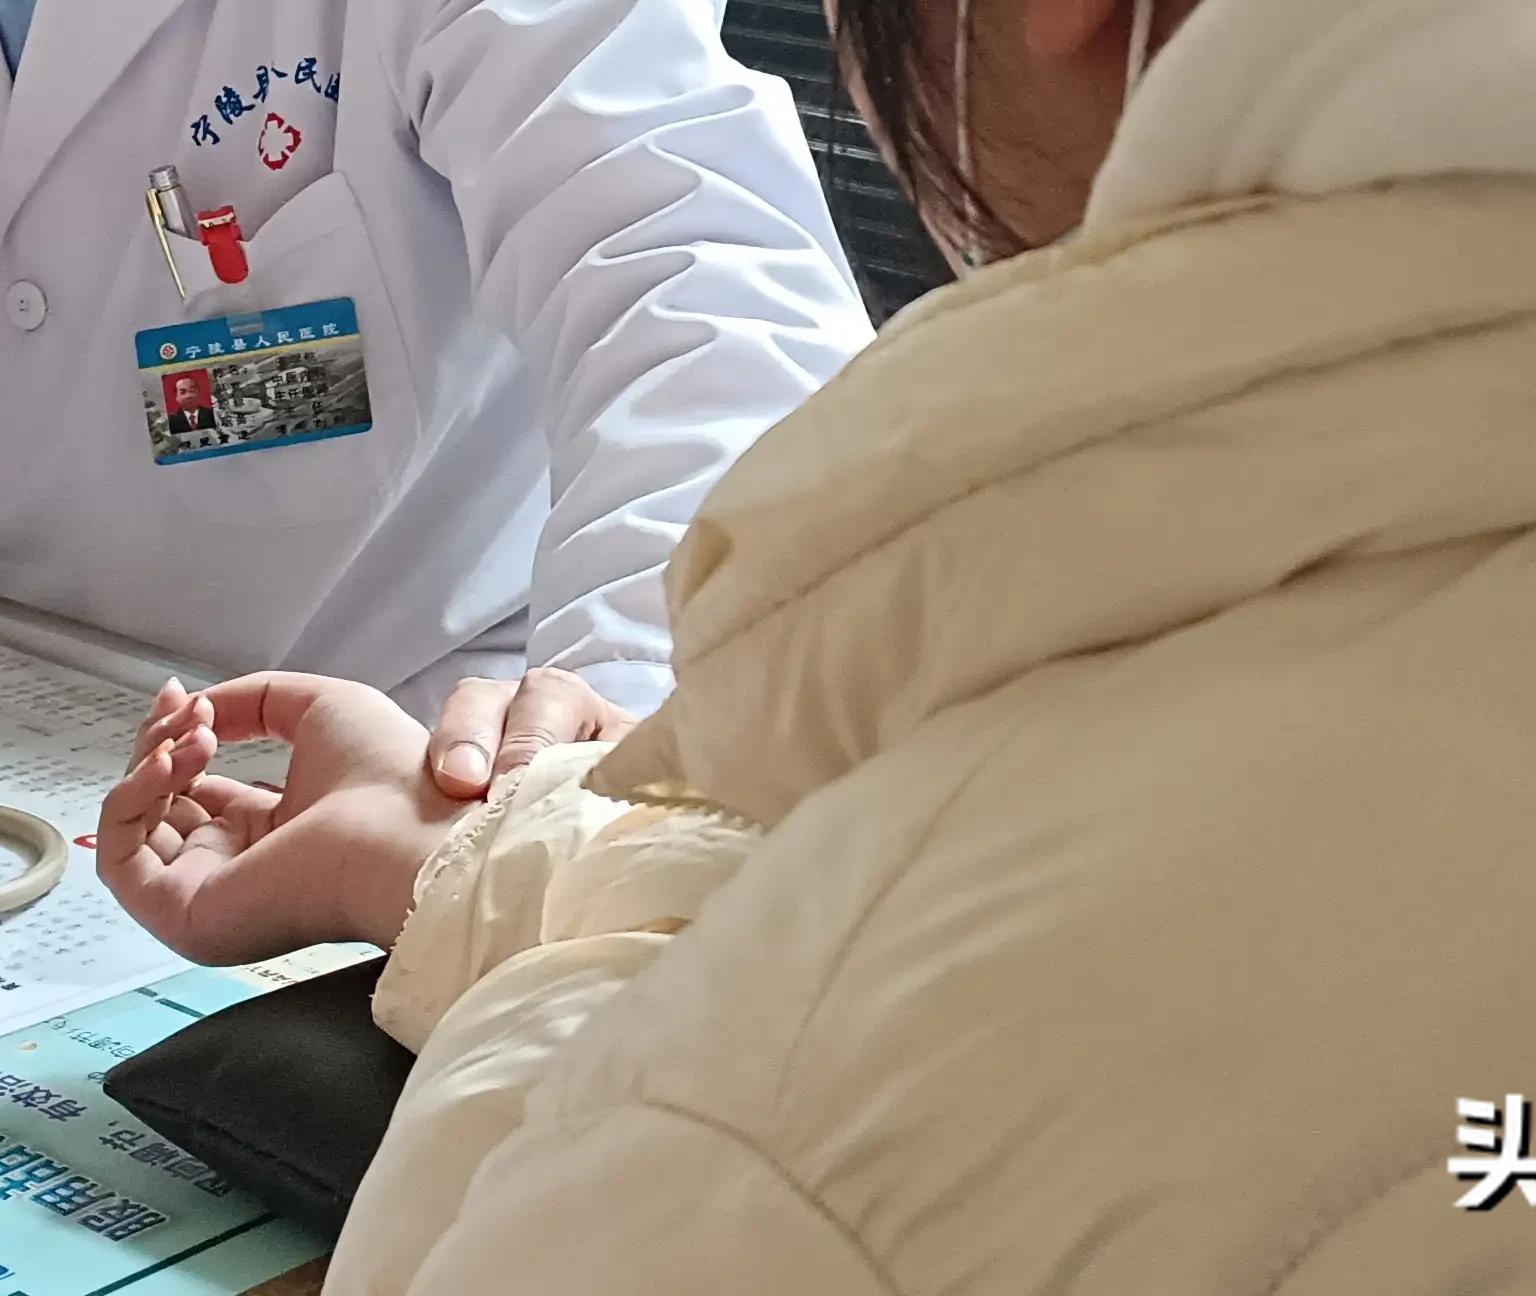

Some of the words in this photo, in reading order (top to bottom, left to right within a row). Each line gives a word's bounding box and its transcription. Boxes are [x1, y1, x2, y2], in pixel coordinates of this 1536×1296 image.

[185, 322, 341, 360] 宁陵县人民医院
